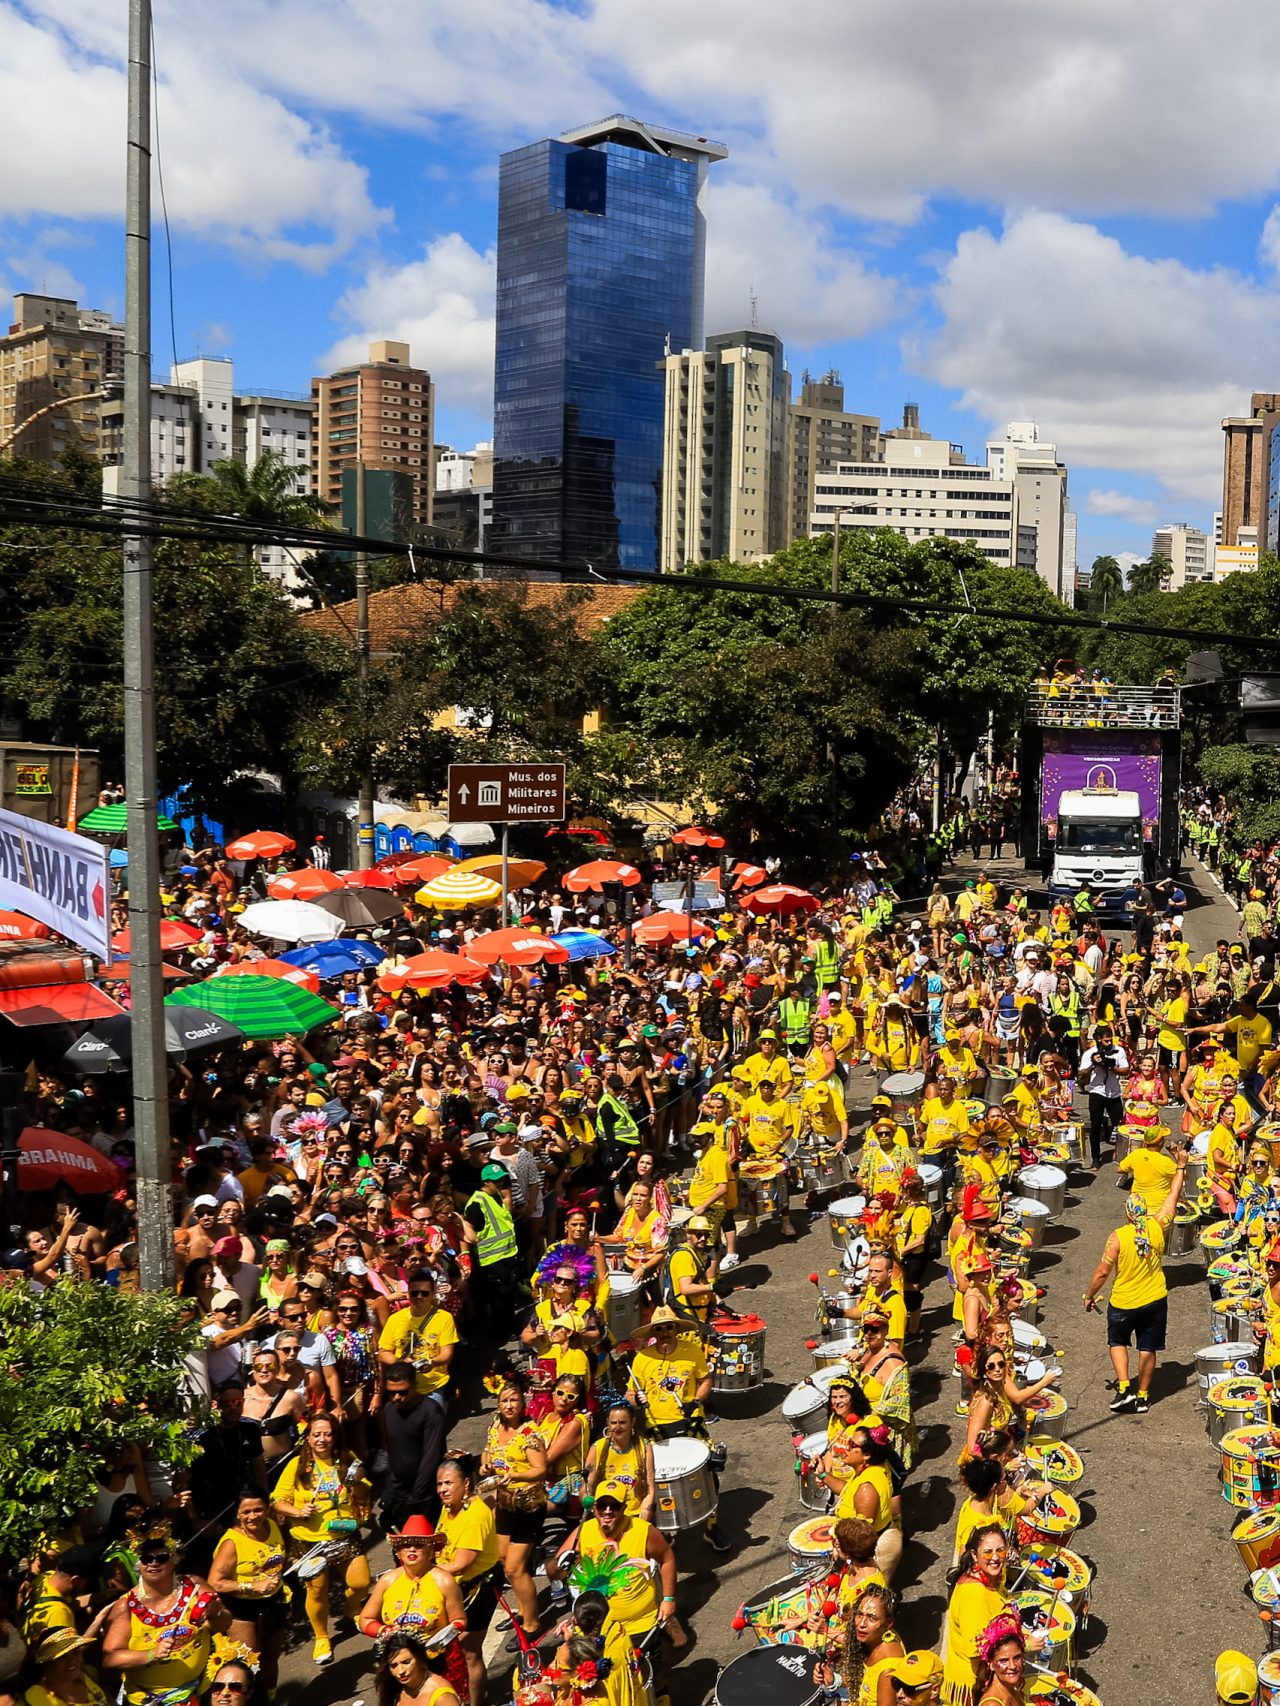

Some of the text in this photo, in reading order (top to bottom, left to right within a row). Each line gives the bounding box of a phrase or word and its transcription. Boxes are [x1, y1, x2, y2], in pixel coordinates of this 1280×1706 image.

[508, 771, 557, 782] Mus. dos
[508, 787, 557, 798] Militares
[507, 803, 555, 814] Mineiros
[185, 1025, 218, 1041] Claro
[78, 1040, 107, 1052] Claro
[18, 1149, 98, 1172] BRAHMA
